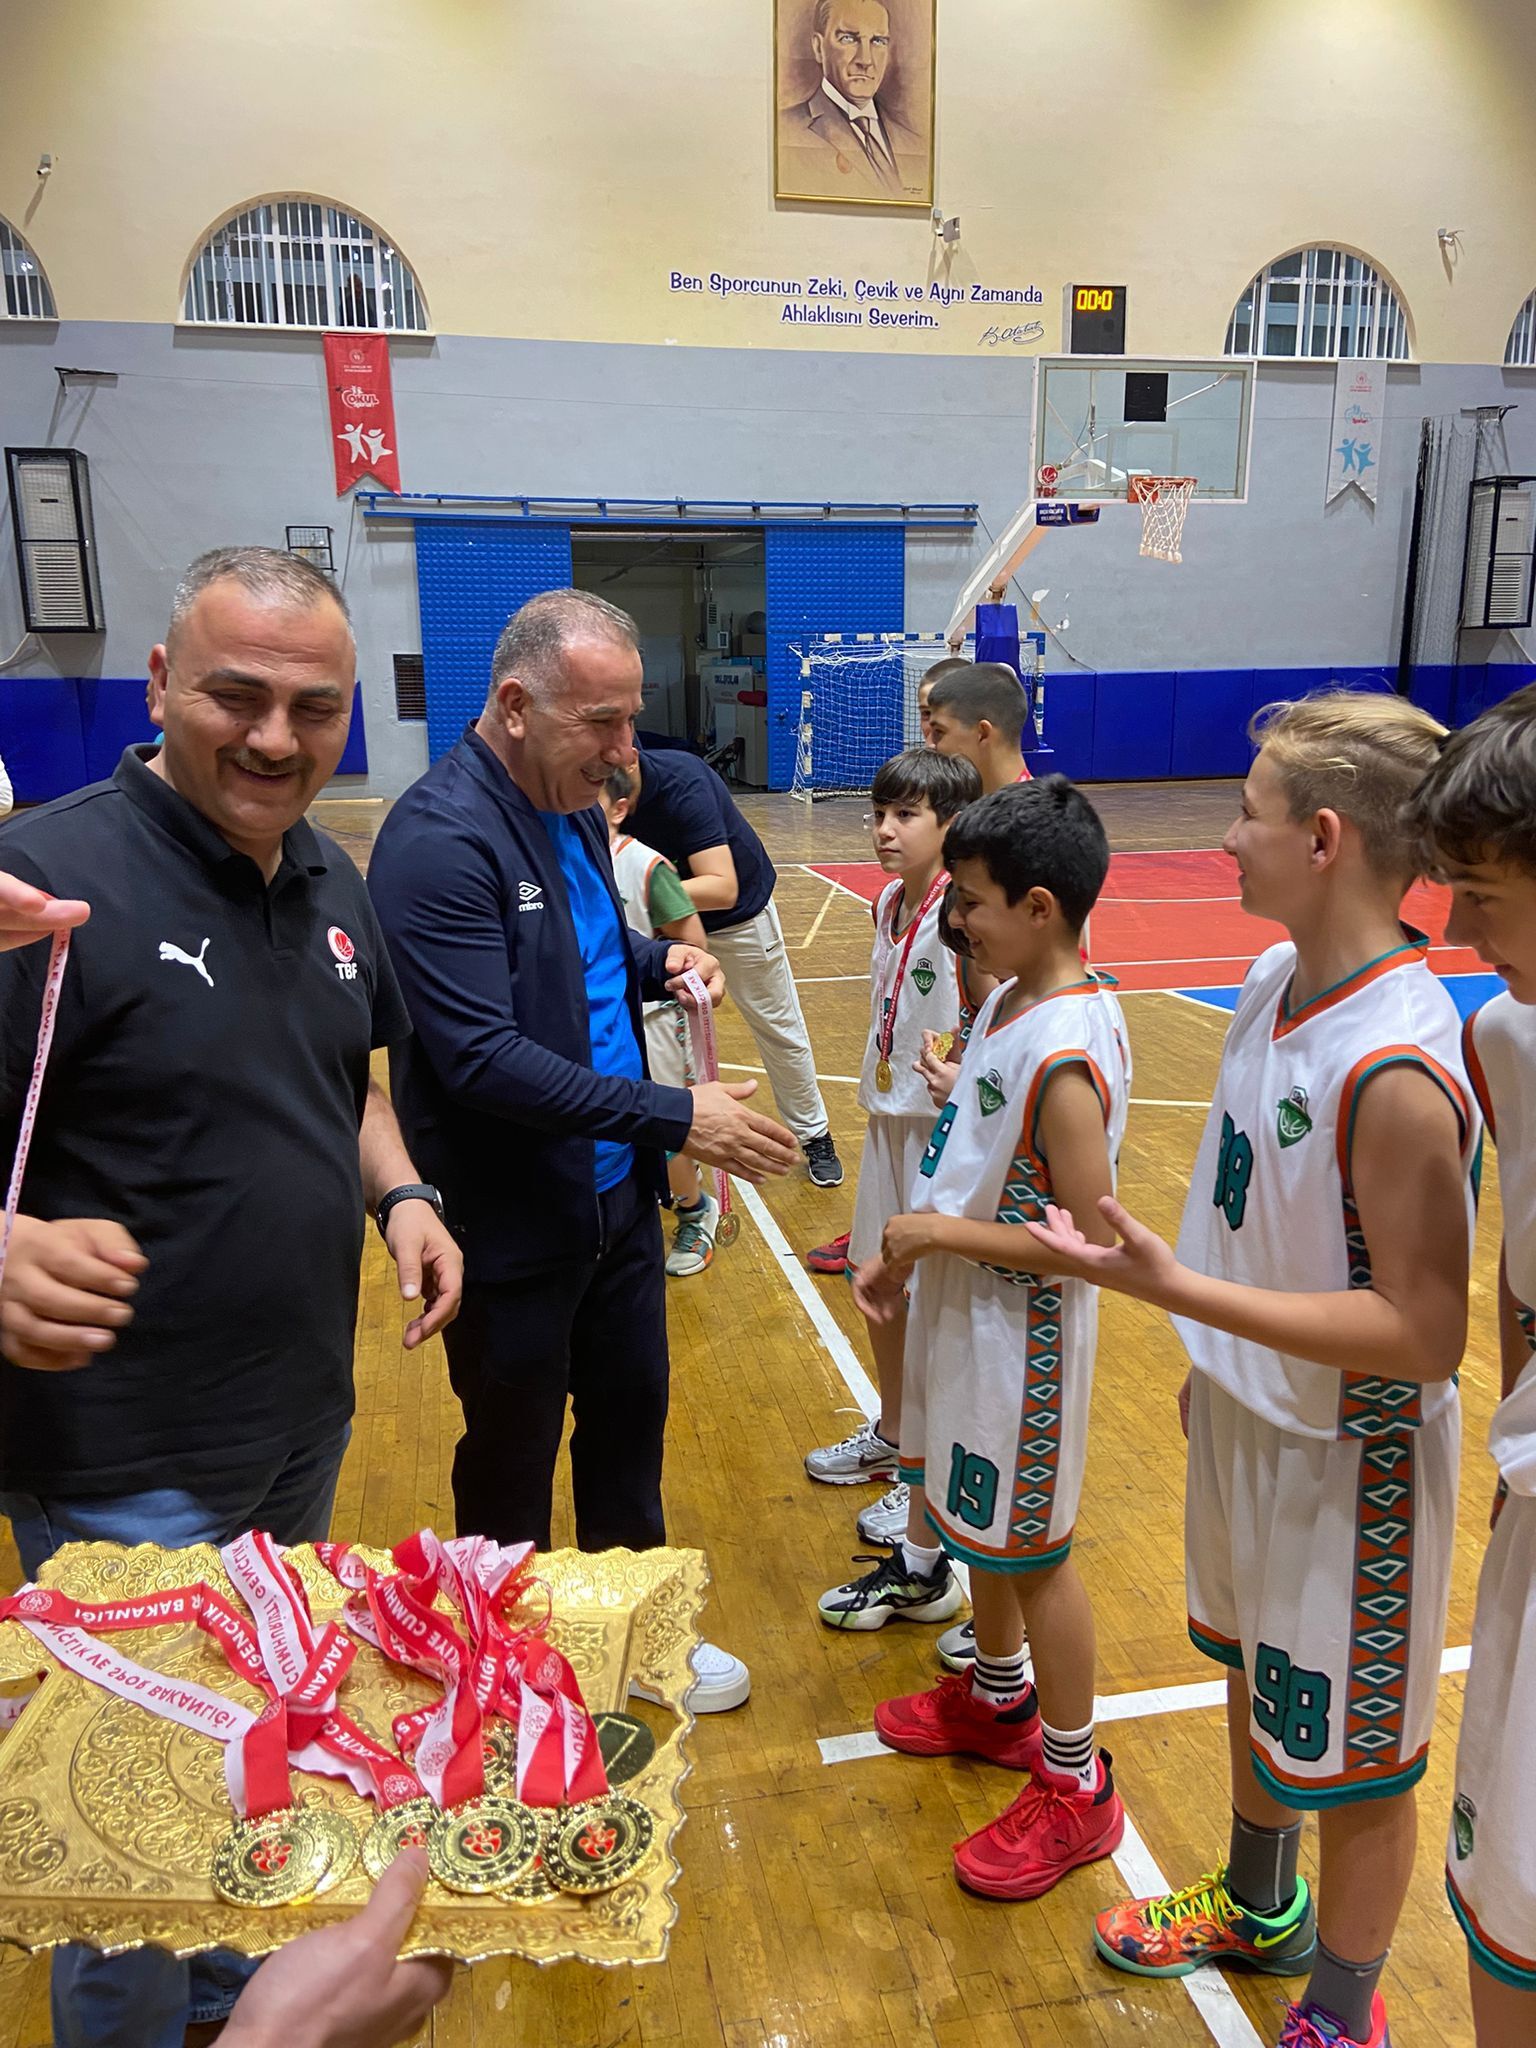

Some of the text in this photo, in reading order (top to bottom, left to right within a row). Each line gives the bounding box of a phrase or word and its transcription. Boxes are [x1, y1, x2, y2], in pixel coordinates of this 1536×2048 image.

[670, 271, 1043, 306] Ben Sporcunun Zeki, Çevik ve Aynı Zamanda
[781, 303, 940, 327] Ahlaklısını Severim.
[1036, 486, 1057, 497] TBF
[335, 963, 358, 980] TBF
[947, 1442, 1000, 1531] 19
[74, 1598, 185, 1623] BAKANLIĞI
[203, 1603, 263, 1668] GENÇLİK
[1253, 1641, 1331, 1762] 98
